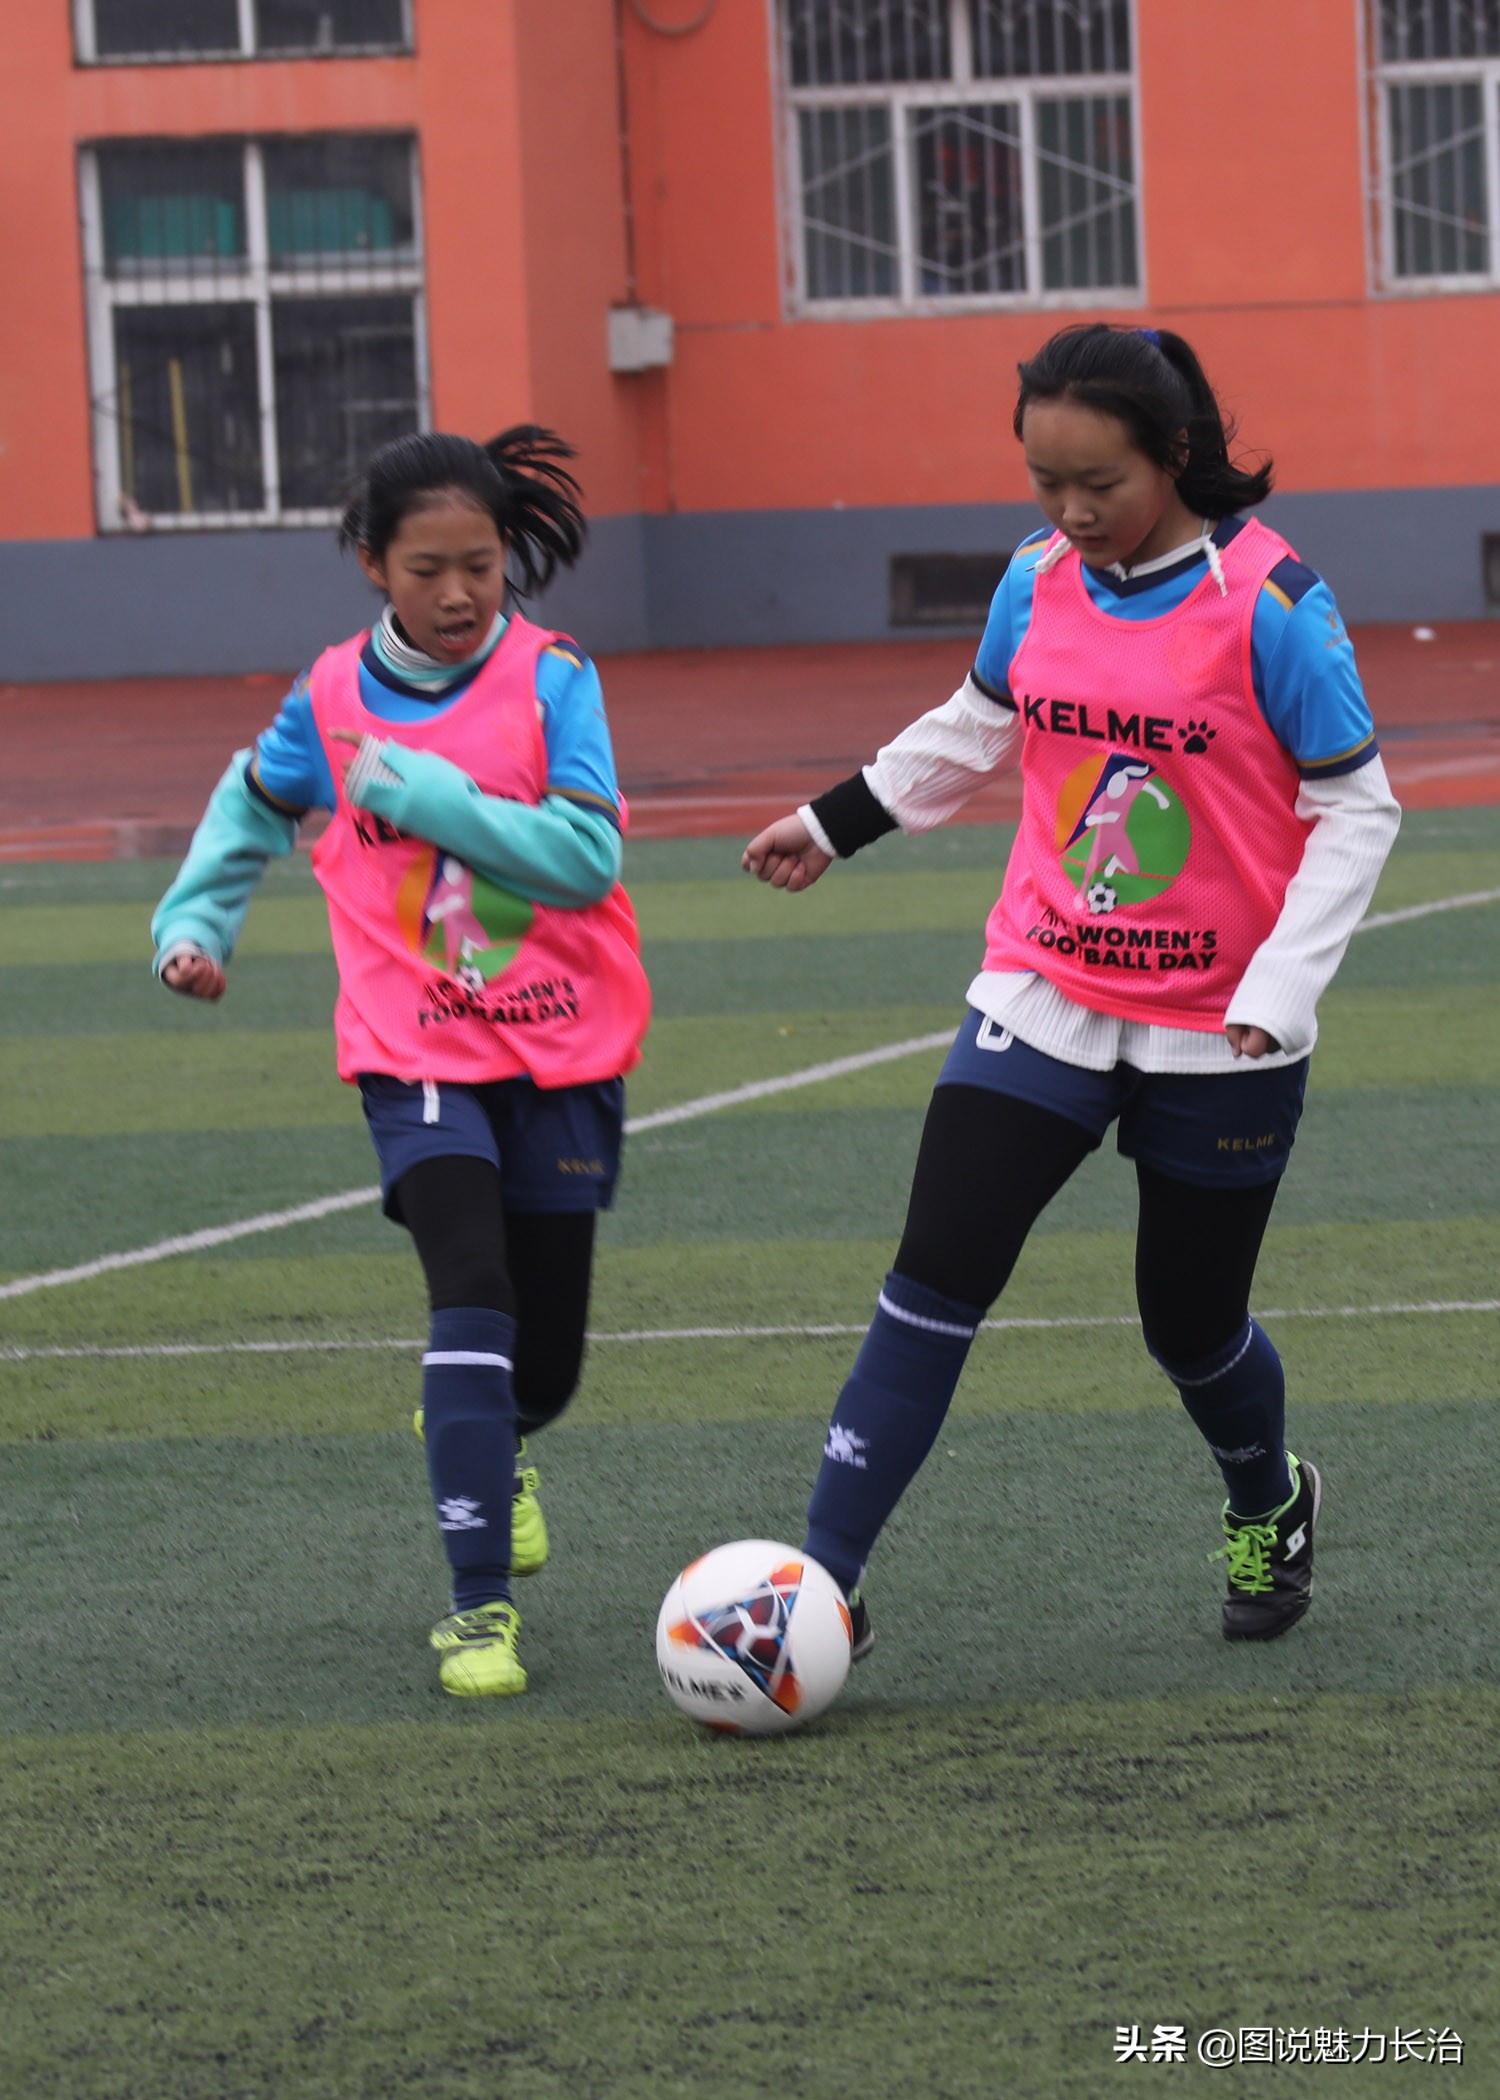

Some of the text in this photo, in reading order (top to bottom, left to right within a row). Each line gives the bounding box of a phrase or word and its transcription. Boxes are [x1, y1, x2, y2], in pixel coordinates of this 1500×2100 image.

[1023, 694, 1174, 752] KELME
[1077, 924, 1217, 950] WOMEN'S
[1158, 952, 1217, 971] DAY
[1217, 1133, 1276, 1151] KELME
